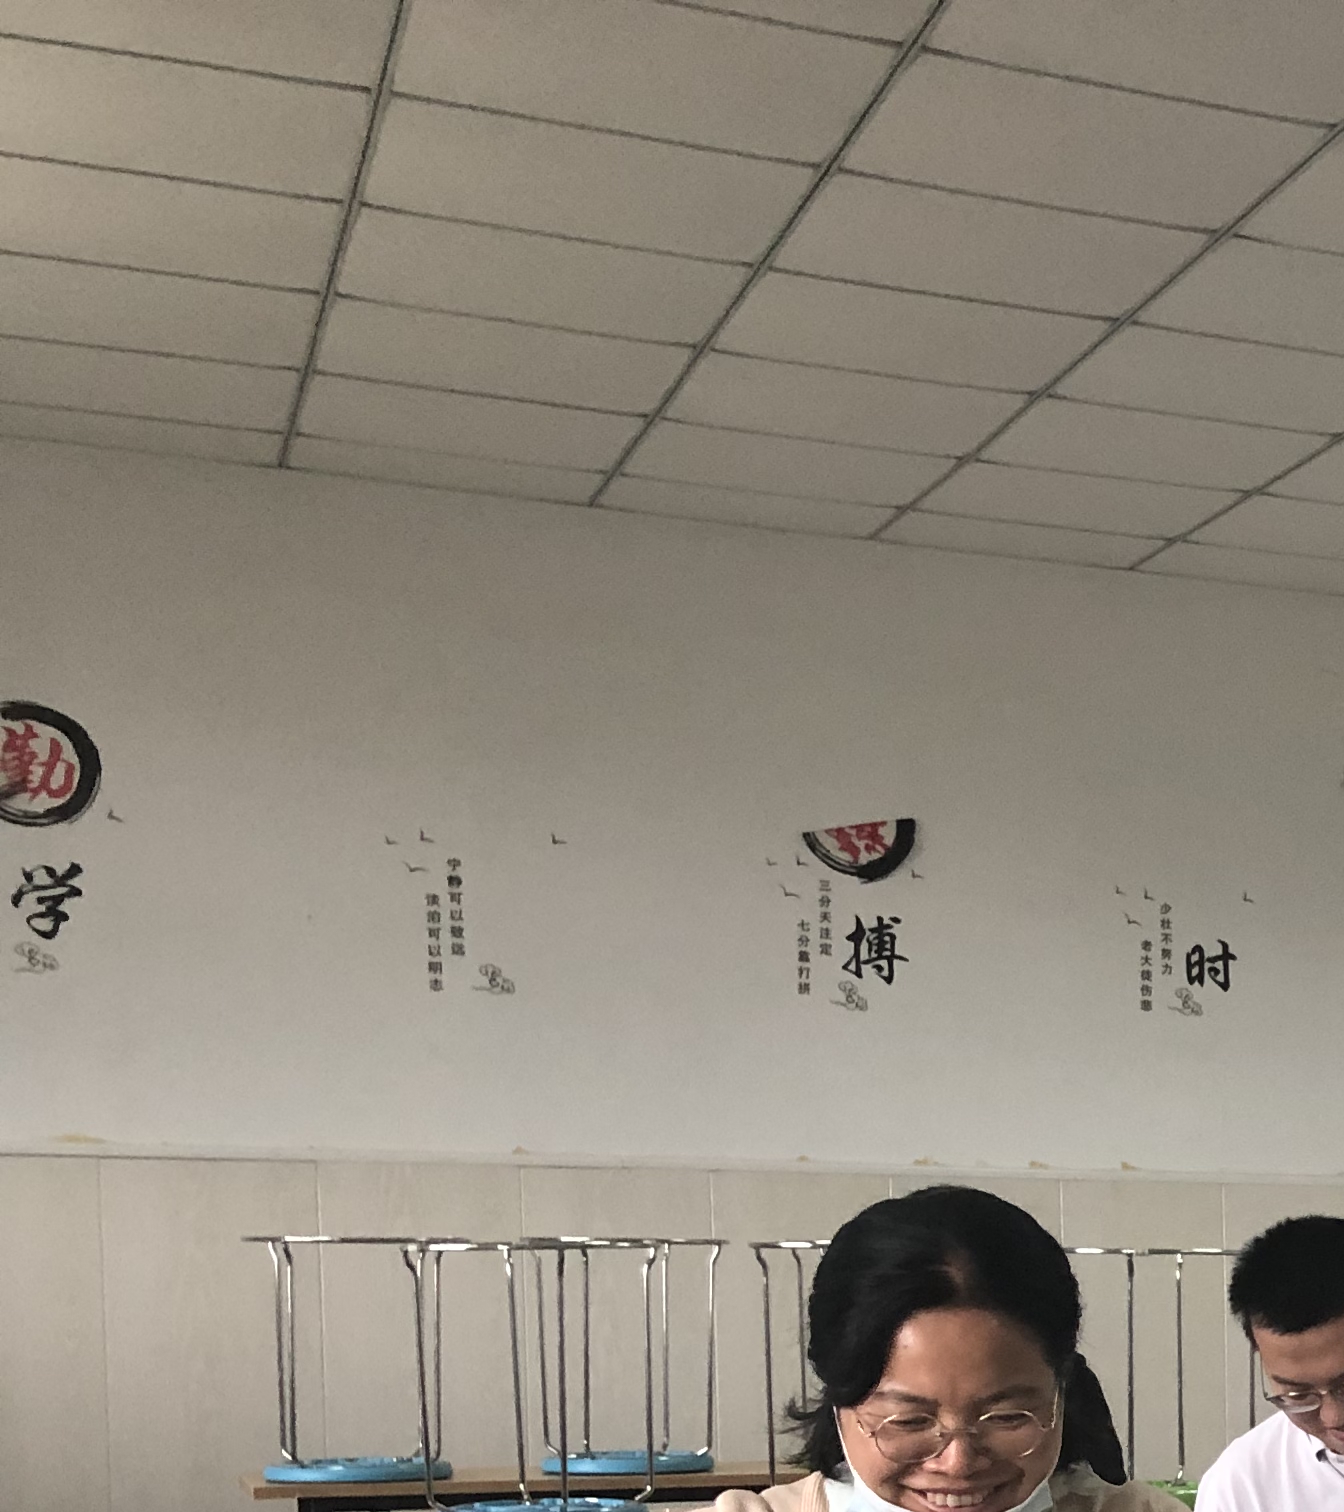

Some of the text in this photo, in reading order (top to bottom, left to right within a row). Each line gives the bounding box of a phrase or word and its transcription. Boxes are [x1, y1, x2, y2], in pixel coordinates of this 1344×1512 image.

[1, 719, 76, 801] 勤
[10, 861, 83, 940] 学
[818, 879, 832, 957] 三分天注定
[797, 919, 811, 996] 七分靠打拼
[841, 914, 909, 986] 搏
[1140, 939, 1153, 1012] 老大徒伤悲
[1159, 902, 1173, 976] 少壮不努力
[1185, 938, 1238, 993] 时
